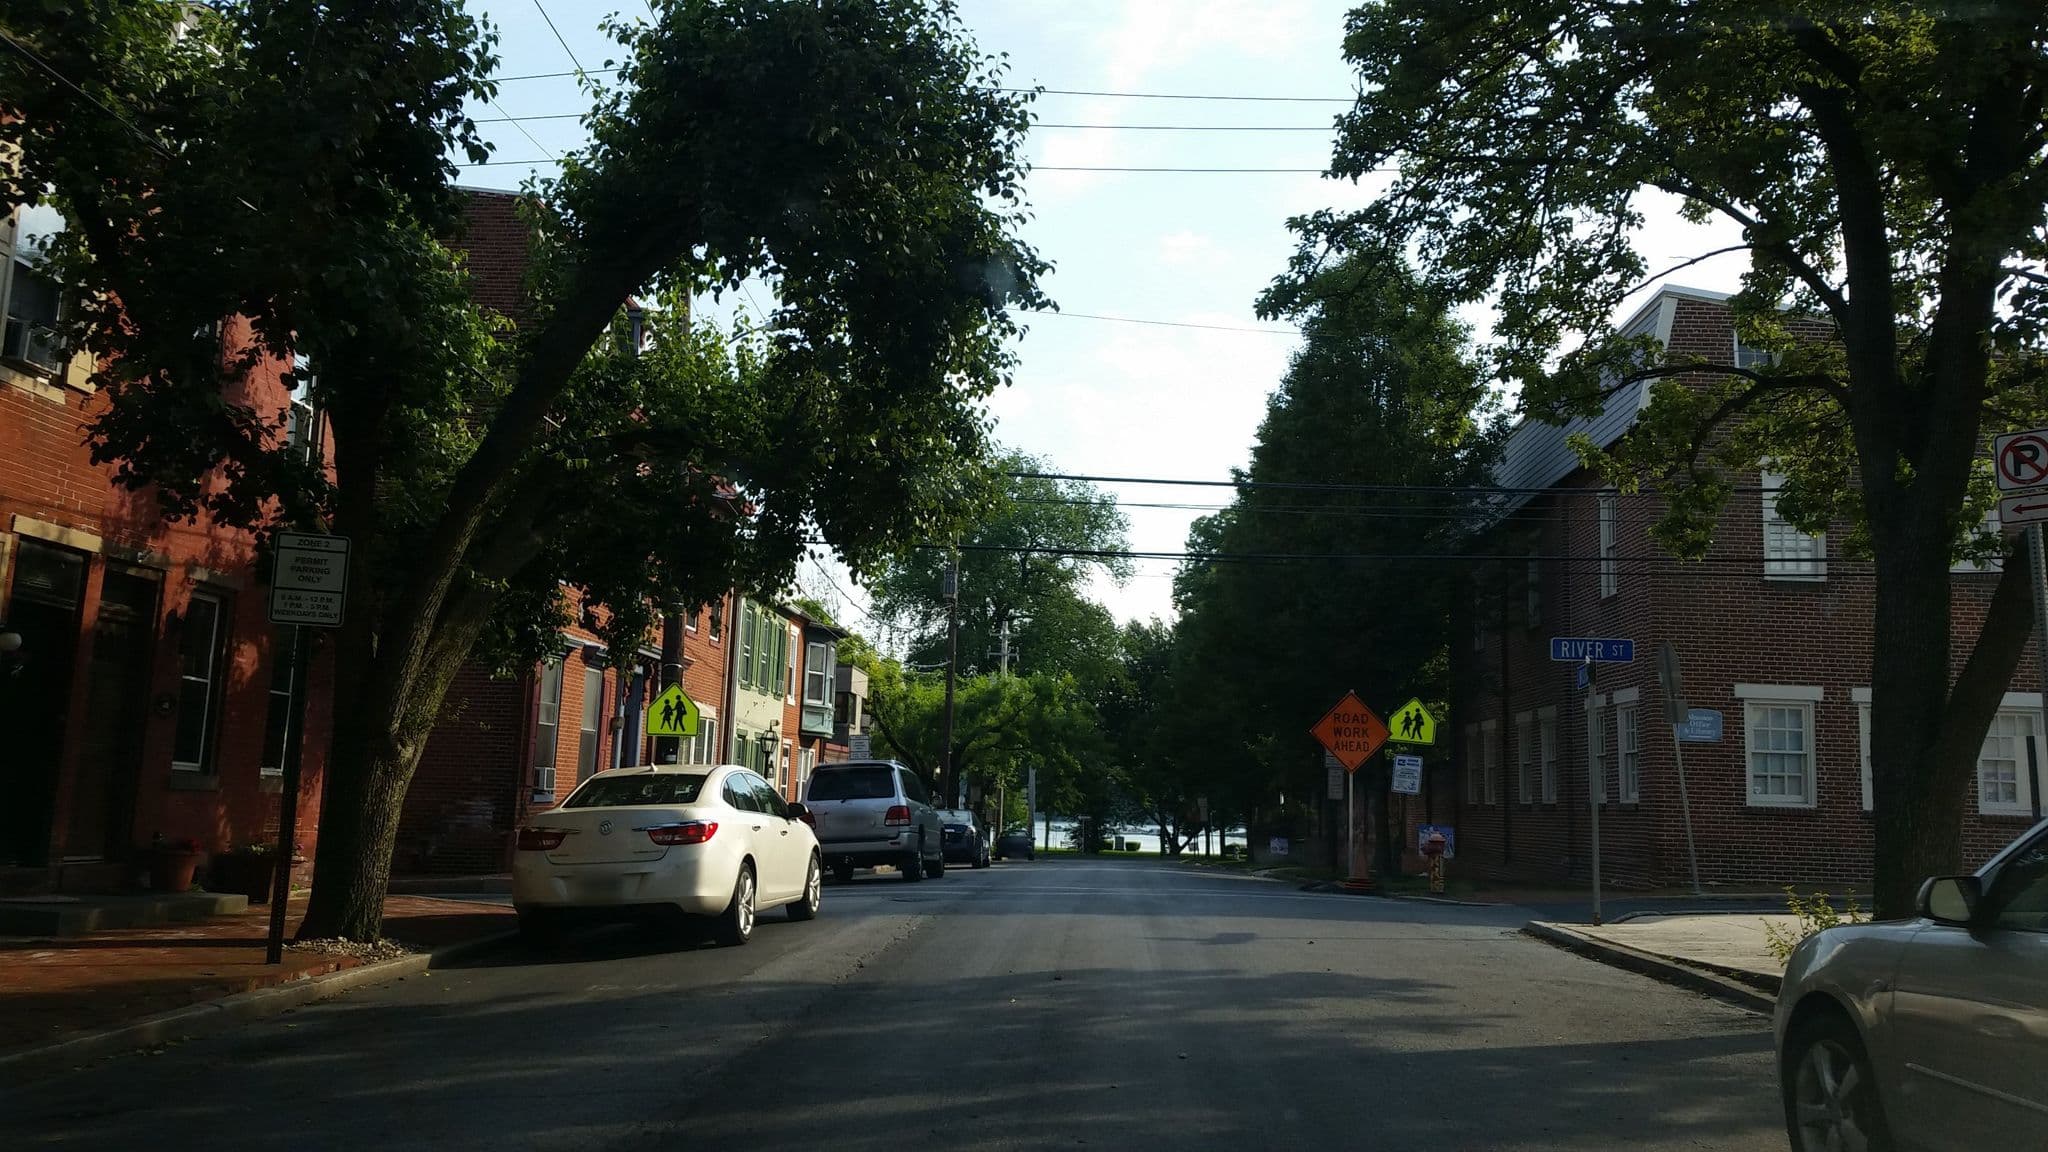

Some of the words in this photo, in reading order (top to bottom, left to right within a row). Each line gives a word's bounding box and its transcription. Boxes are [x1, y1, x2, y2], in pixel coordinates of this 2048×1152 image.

[297, 538, 322, 548] ZONE
[324, 540, 331, 548] 2
[294, 556, 329, 566] PERMIT
[290, 565, 331, 576] PARKING
[297, 574, 322, 584] ONLY
[274, 608, 317, 618] WEEKDAYS
[318, 610, 338, 619] ONLY
[1561, 640, 1604, 659] RIVER
[1611, 643, 1625, 657] ST
[1333, 712, 1369, 724] ROAD
[1333, 726, 1370, 738] WORK
[1334, 740, 1370, 752] AHEAD
